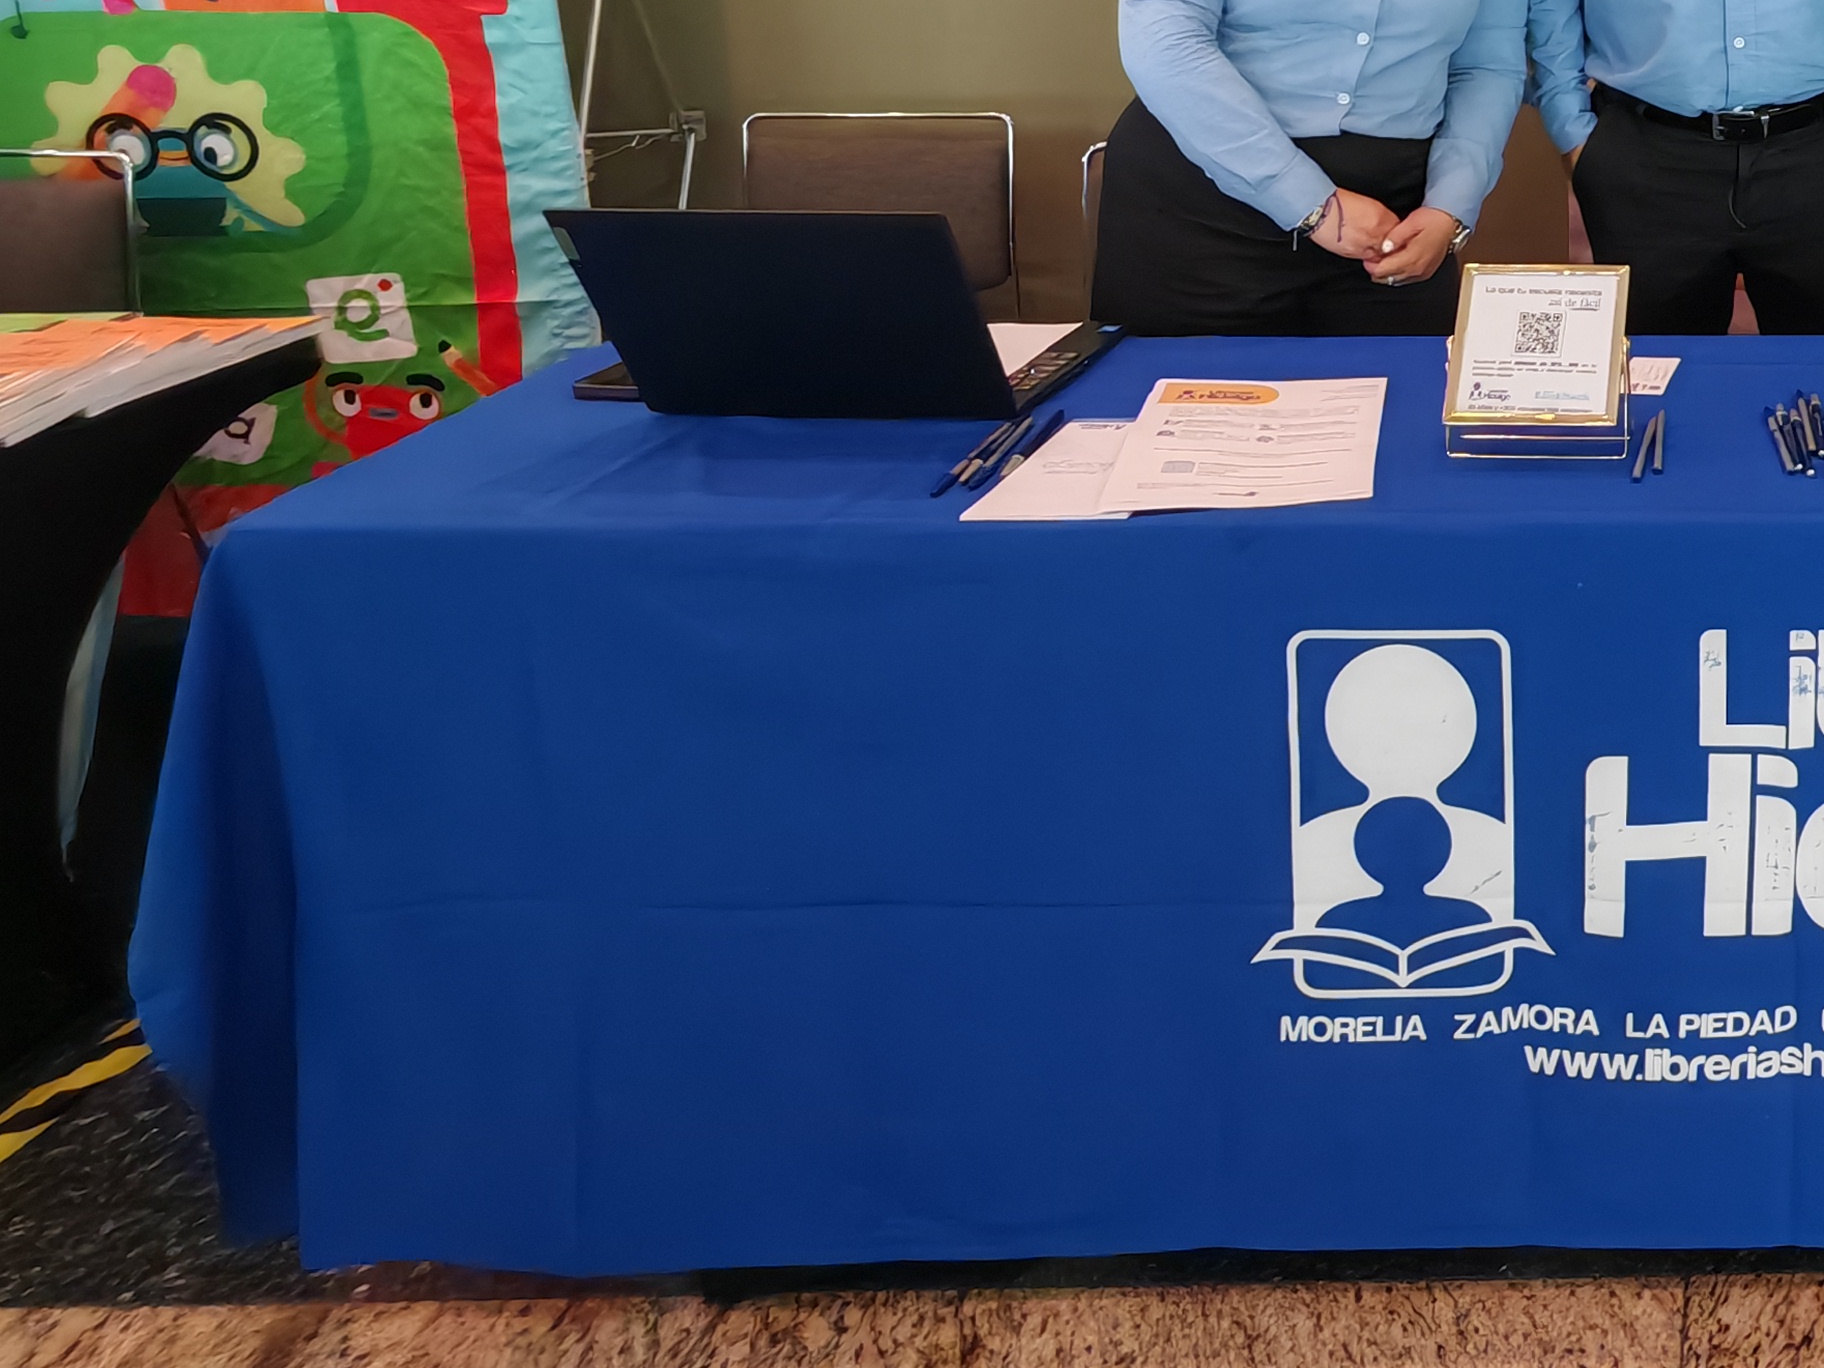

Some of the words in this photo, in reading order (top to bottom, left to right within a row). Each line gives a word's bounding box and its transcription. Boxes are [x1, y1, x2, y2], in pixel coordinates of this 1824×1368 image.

[1279, 1014, 1427, 1043] MORELIA
[1453, 1003, 1600, 1040] ZAMORA
[1625, 1012, 1670, 1039] LA
[1678, 1005, 1798, 1039] PIEDAD
